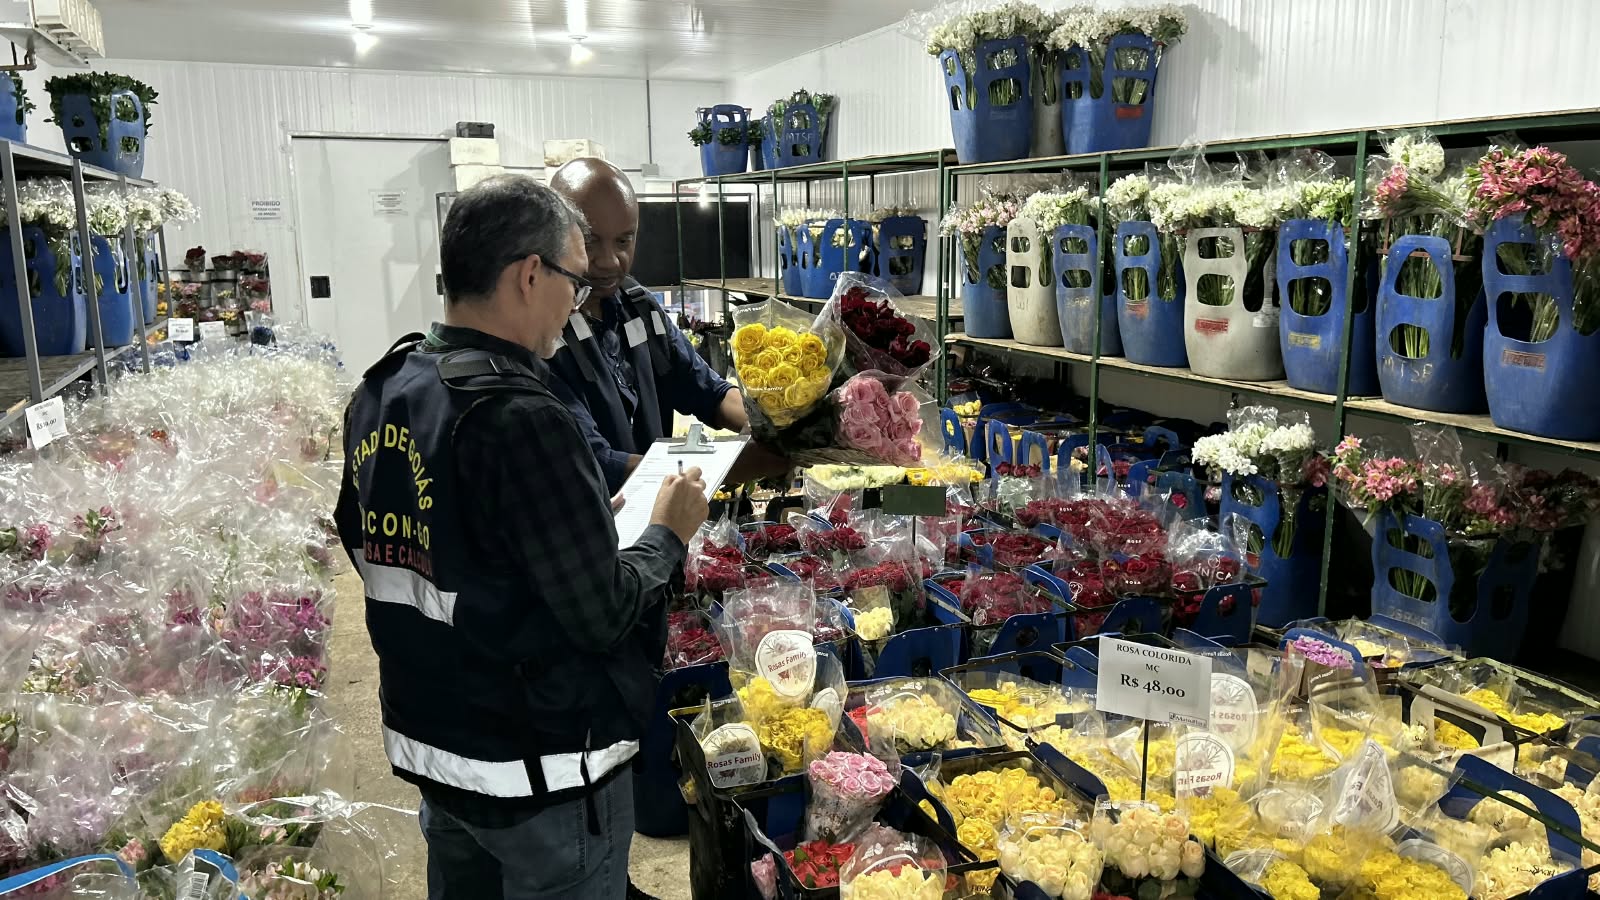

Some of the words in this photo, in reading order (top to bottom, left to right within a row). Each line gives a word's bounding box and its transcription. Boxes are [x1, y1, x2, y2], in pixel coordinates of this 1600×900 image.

[384, 423, 409, 452] DE
[407, 439, 434, 510] GOIÁS
[767, 659, 786, 672] Rosas
[1116, 643, 1140, 655] ROSA
[1142, 649, 1192, 666] COLORIDA
[1120, 673, 1139, 688] R$
[1142, 680, 1185, 698] 48,00
[707, 759, 733, 769] Rosas
[734, 752, 761, 764] Family
